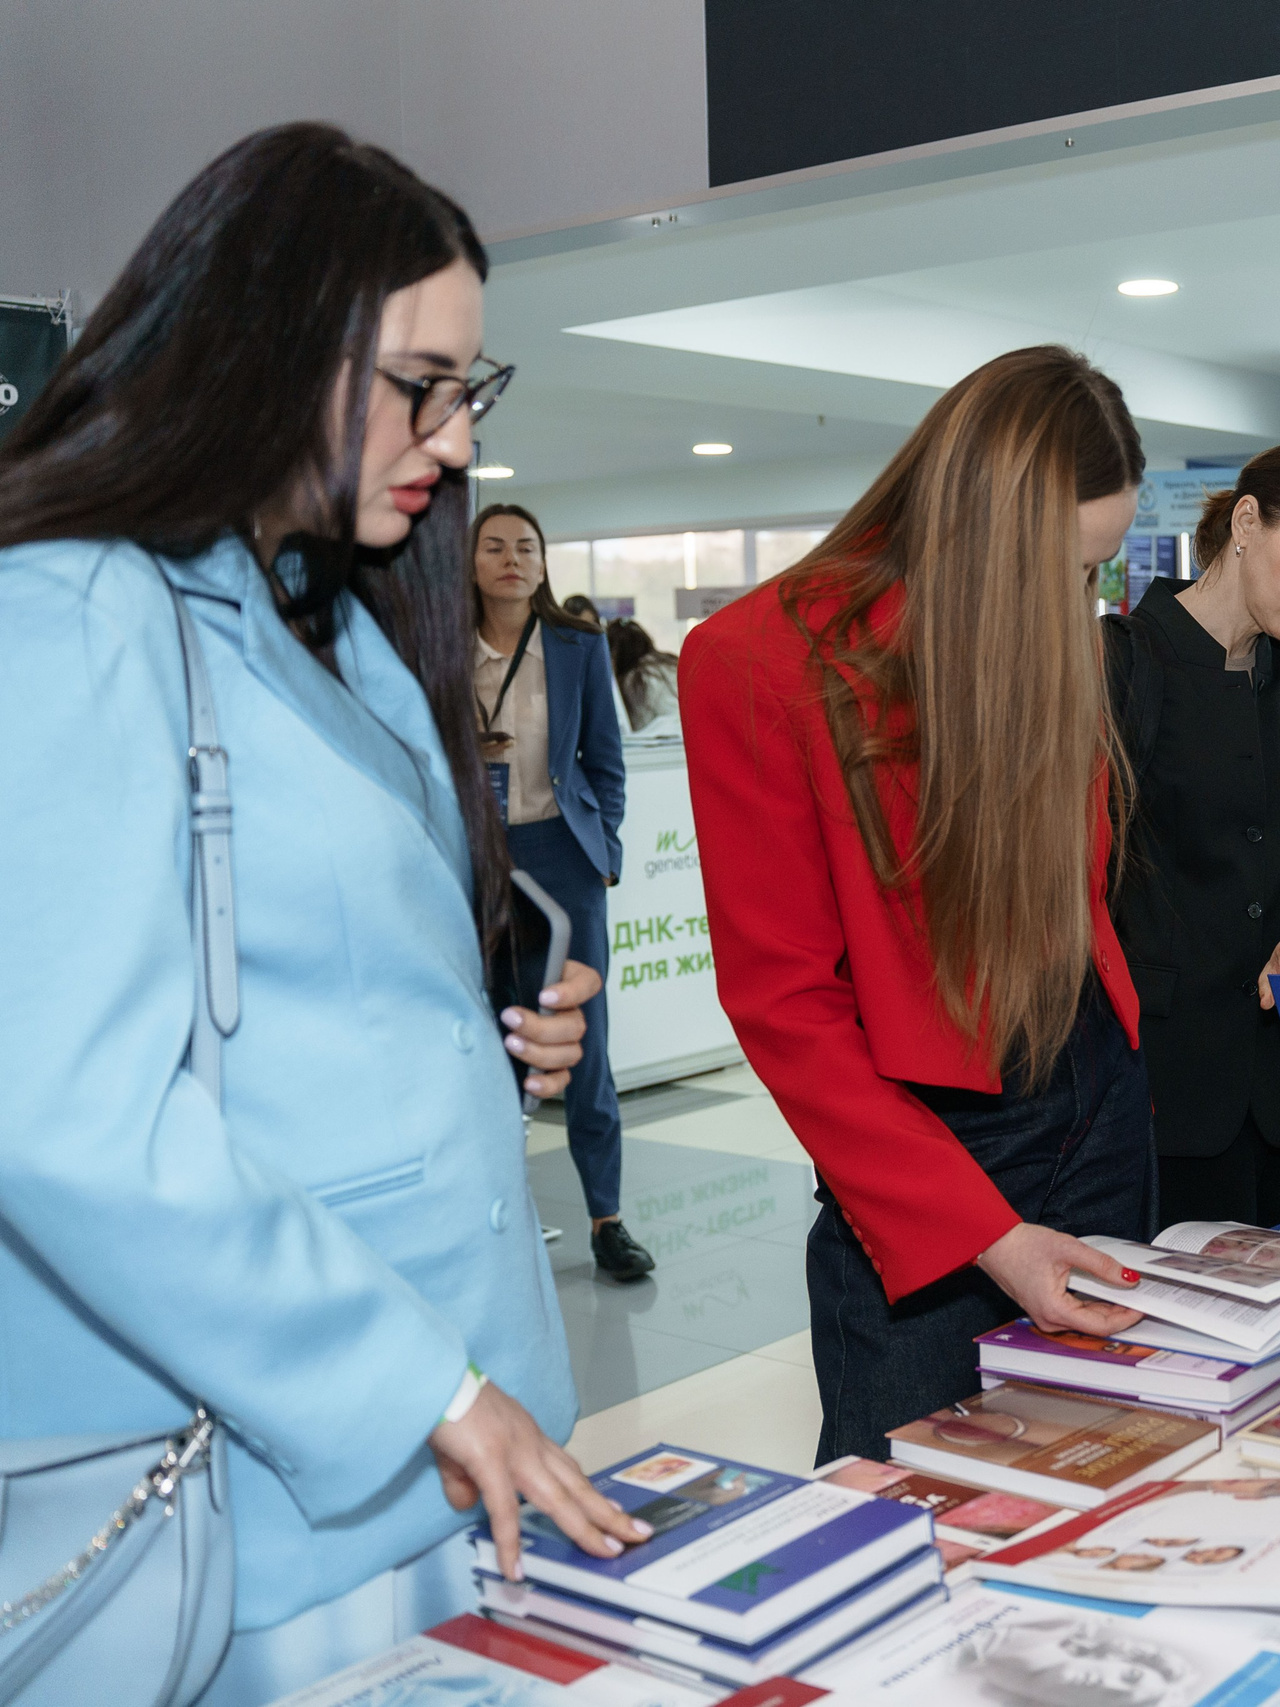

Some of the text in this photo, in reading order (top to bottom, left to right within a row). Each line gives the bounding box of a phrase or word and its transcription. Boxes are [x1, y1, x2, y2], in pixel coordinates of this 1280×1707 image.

[612, 914, 709, 954] ДНК-те
[620, 952, 715, 991] для жи
